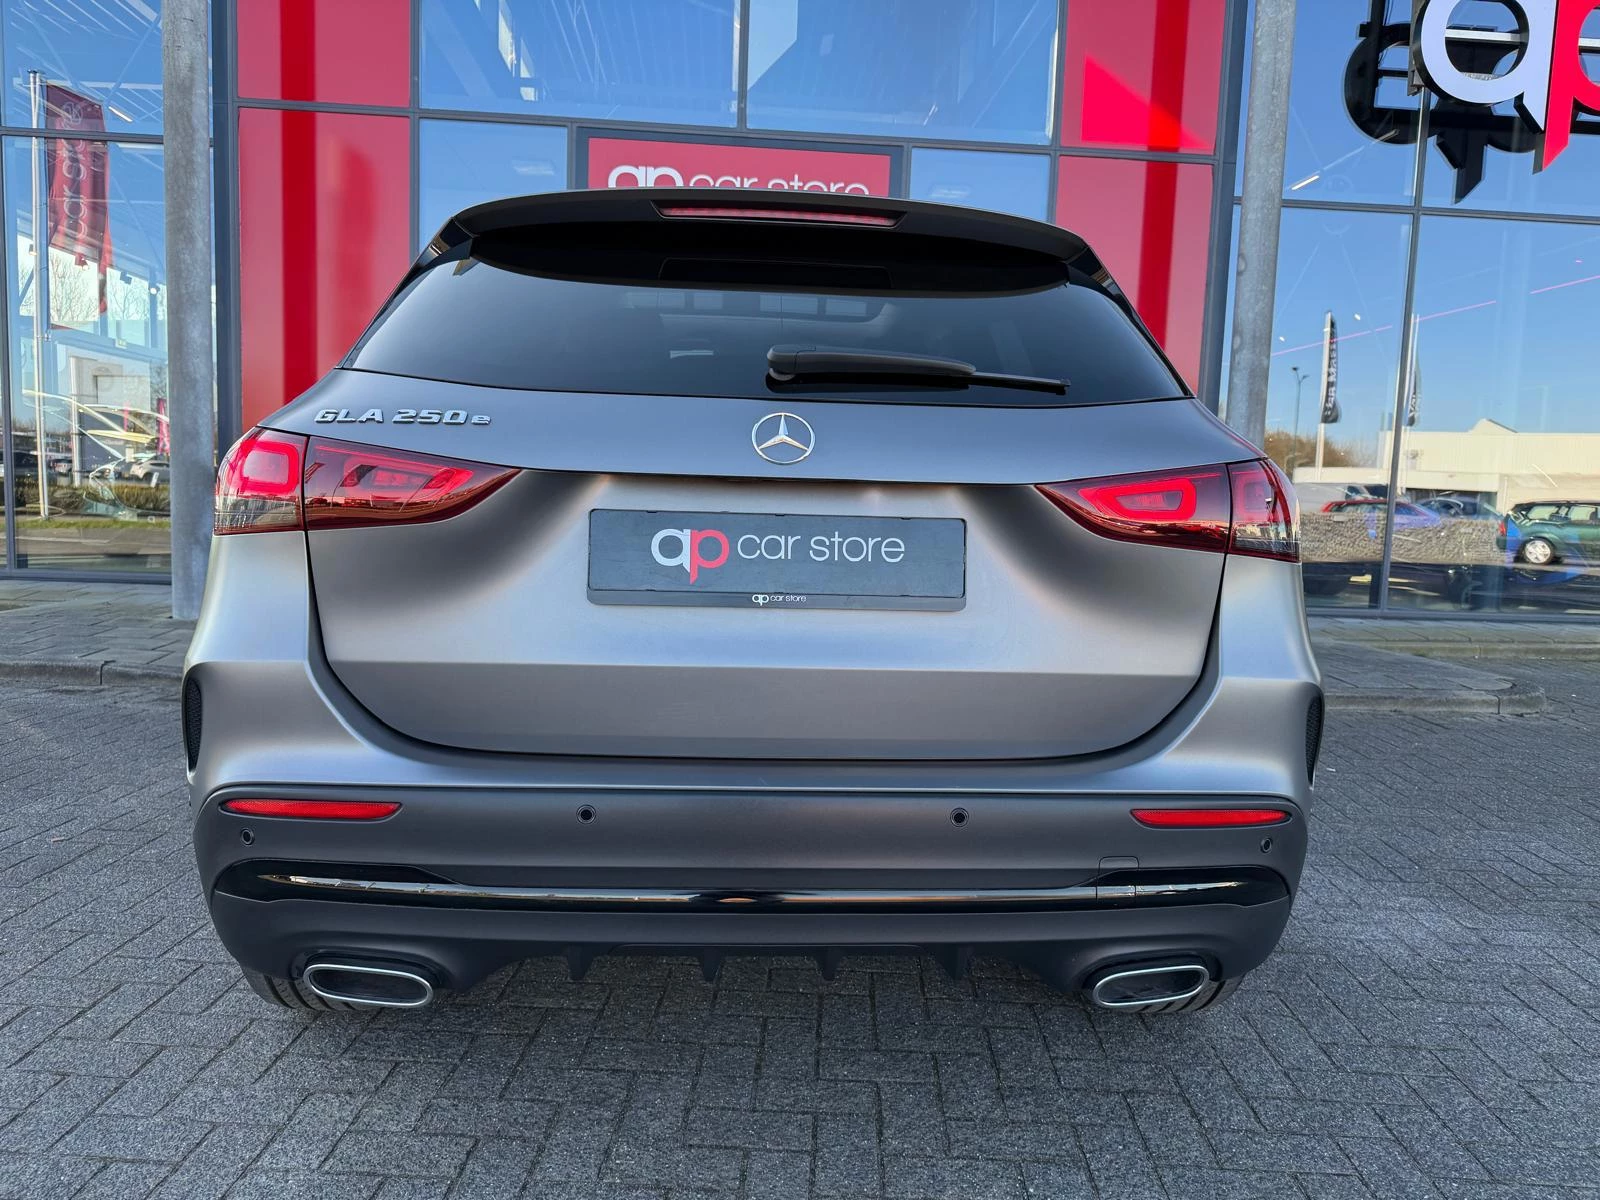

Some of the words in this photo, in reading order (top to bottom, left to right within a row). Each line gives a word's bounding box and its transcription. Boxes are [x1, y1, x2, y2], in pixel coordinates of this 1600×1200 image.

[314, 408, 384, 424] GLA
[650, 528, 730, 585] ap
[737, 534, 801, 560] car
[809, 531, 906, 563] store
[785, 594, 807, 603] store
